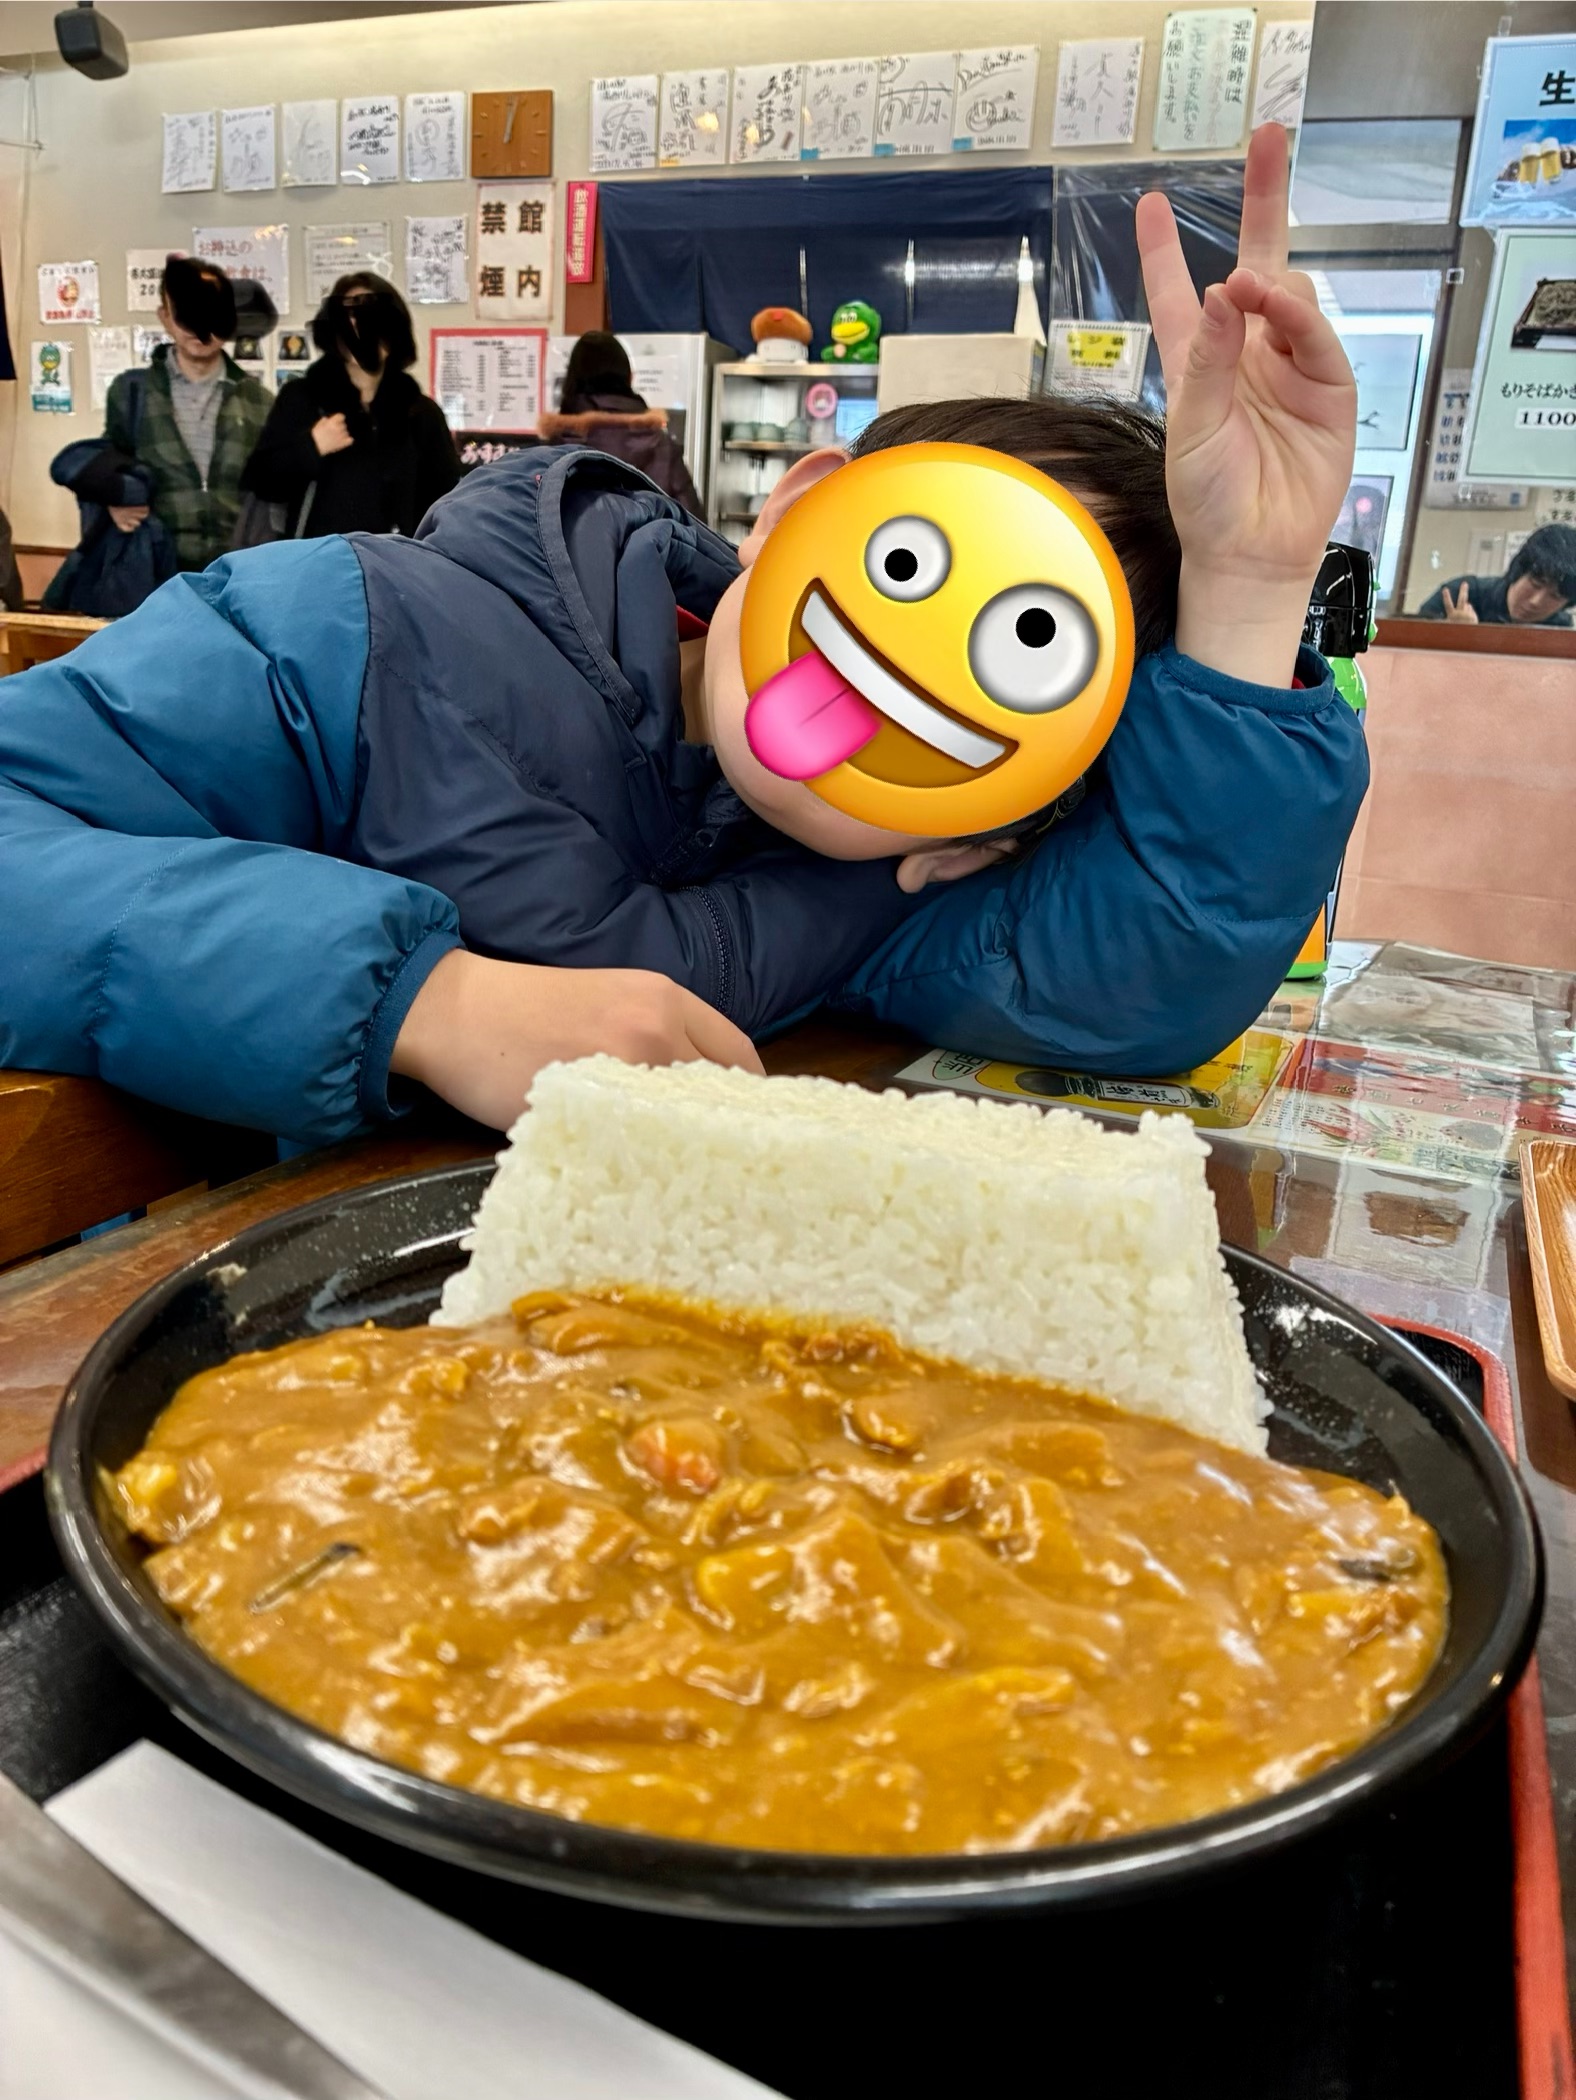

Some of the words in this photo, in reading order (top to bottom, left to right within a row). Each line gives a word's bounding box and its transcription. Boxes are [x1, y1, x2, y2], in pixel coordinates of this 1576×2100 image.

[1539, 70, 1576, 106] 生
[480, 202, 507, 298] 禁煙
[518, 200, 545, 298] 館内
[1521, 411, 1576, 426] 1100
[461, 441, 520, 465] おすす
